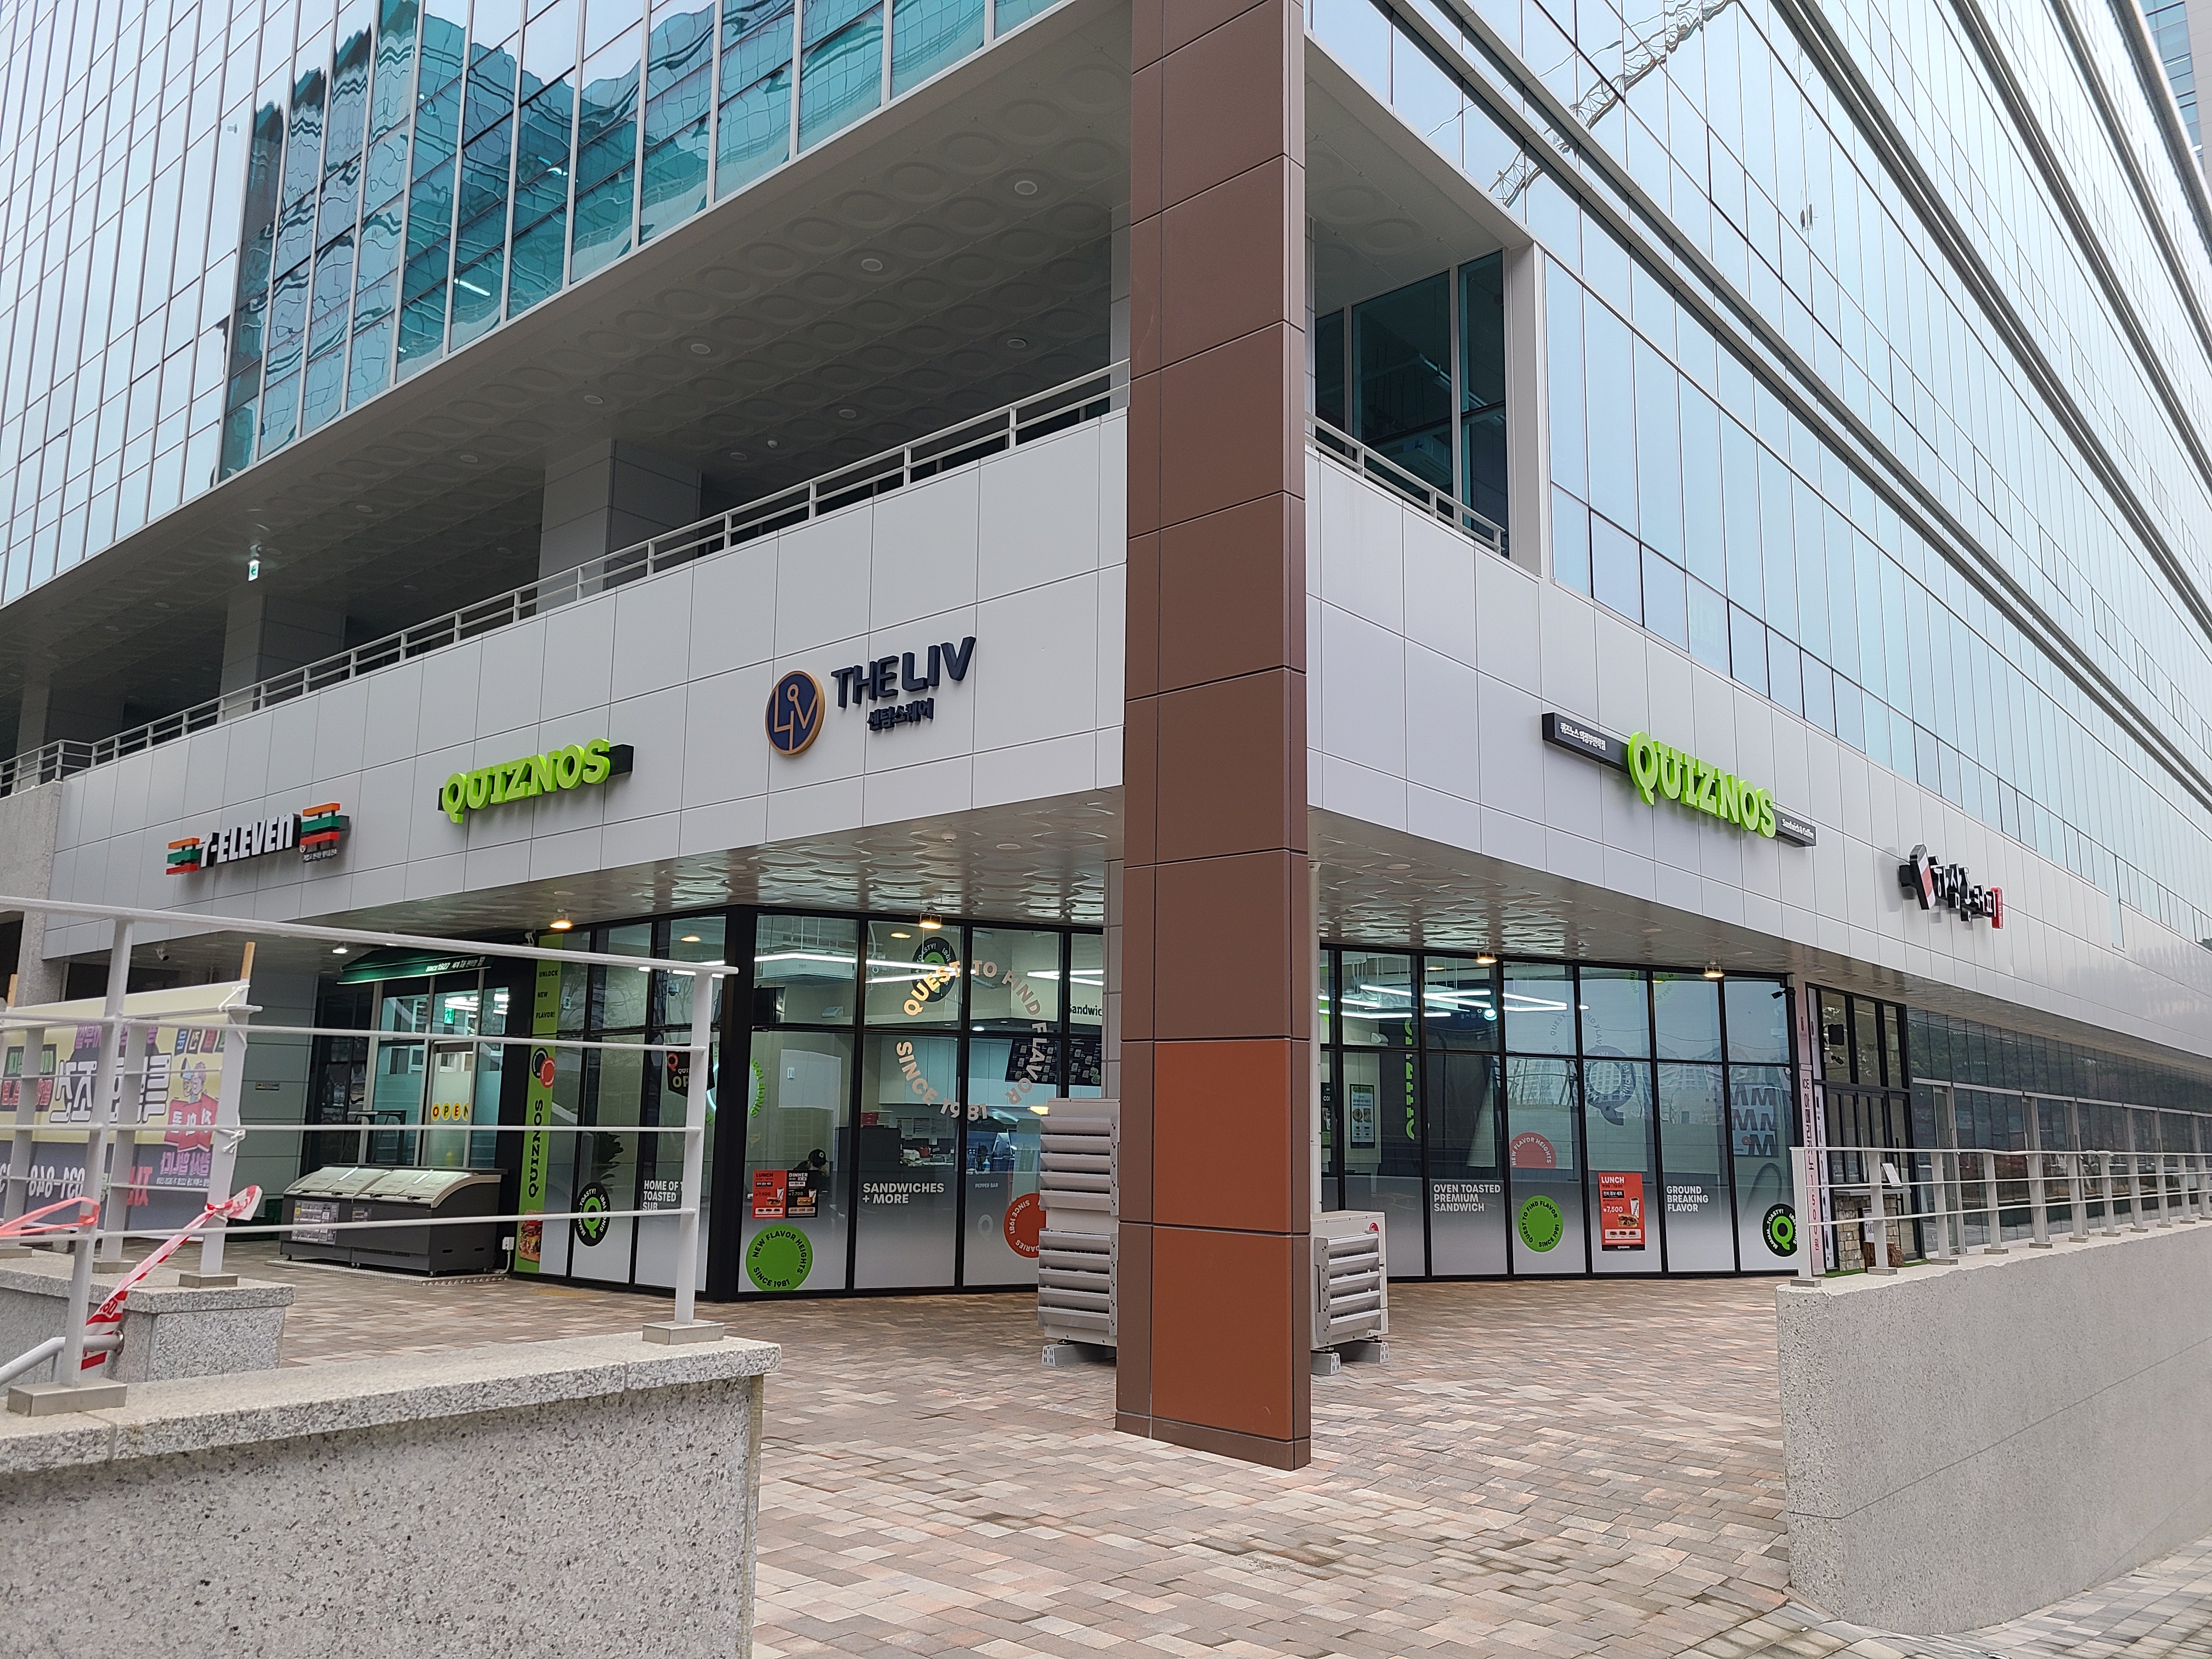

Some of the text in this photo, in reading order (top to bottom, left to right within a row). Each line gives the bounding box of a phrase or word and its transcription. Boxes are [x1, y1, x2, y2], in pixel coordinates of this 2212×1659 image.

[831, 636, 976, 708] THE LIV
[442, 738, 611, 823] QUIZNOS
[1628, 731, 1776, 838] QUIZNOS
[973, 960, 997, 978] TO
[903, 961, 961, 1015] QUEST
[1001, 969, 1041, 1015] FIND
[1004, 1022, 1048, 1105] FLAVOR
[896, 1041, 988, 1121] SINCE 1981
[432, 1105, 469, 1118] OPEN
[528, 1099, 543, 1198] QUIZNOS
[1514, 1137, 1534, 1150] FLAVOR
[1535, 1138, 1552, 1164] HEIGHTS
[644, 1180, 667, 1191] HOME
[668, 1181, 679, 1191] OF
[862, 1183, 944, 1193] SANDWICHES
[1434, 1184, 1501, 1193] OVEN TOASTED
[1666, 1186, 1702, 1194] GROUND
[643, 1191, 676, 1202] TOASTED
[872, 1194, 909, 1204] MORE
[1434, 1193, 1479, 1203] PREMIUM
[1667, 1194, 1709, 1203] BREAKING
[642, 1201, 658, 1211] SUB
[1012, 1200, 1030, 1217] SINCE
[1434, 1203, 1485, 1212] SANDWICH
[1667, 1203, 1699, 1212] FLAVOR
[1522, 1200, 1558, 1243] QUEST TO FIND FLAVOR
[1538, 1236, 1554, 1247] SINCE
[752, 1231, 807, 1274] NEW FLAVOR HEIGHTS
[753, 1267, 791, 1288] SINCE 1981
